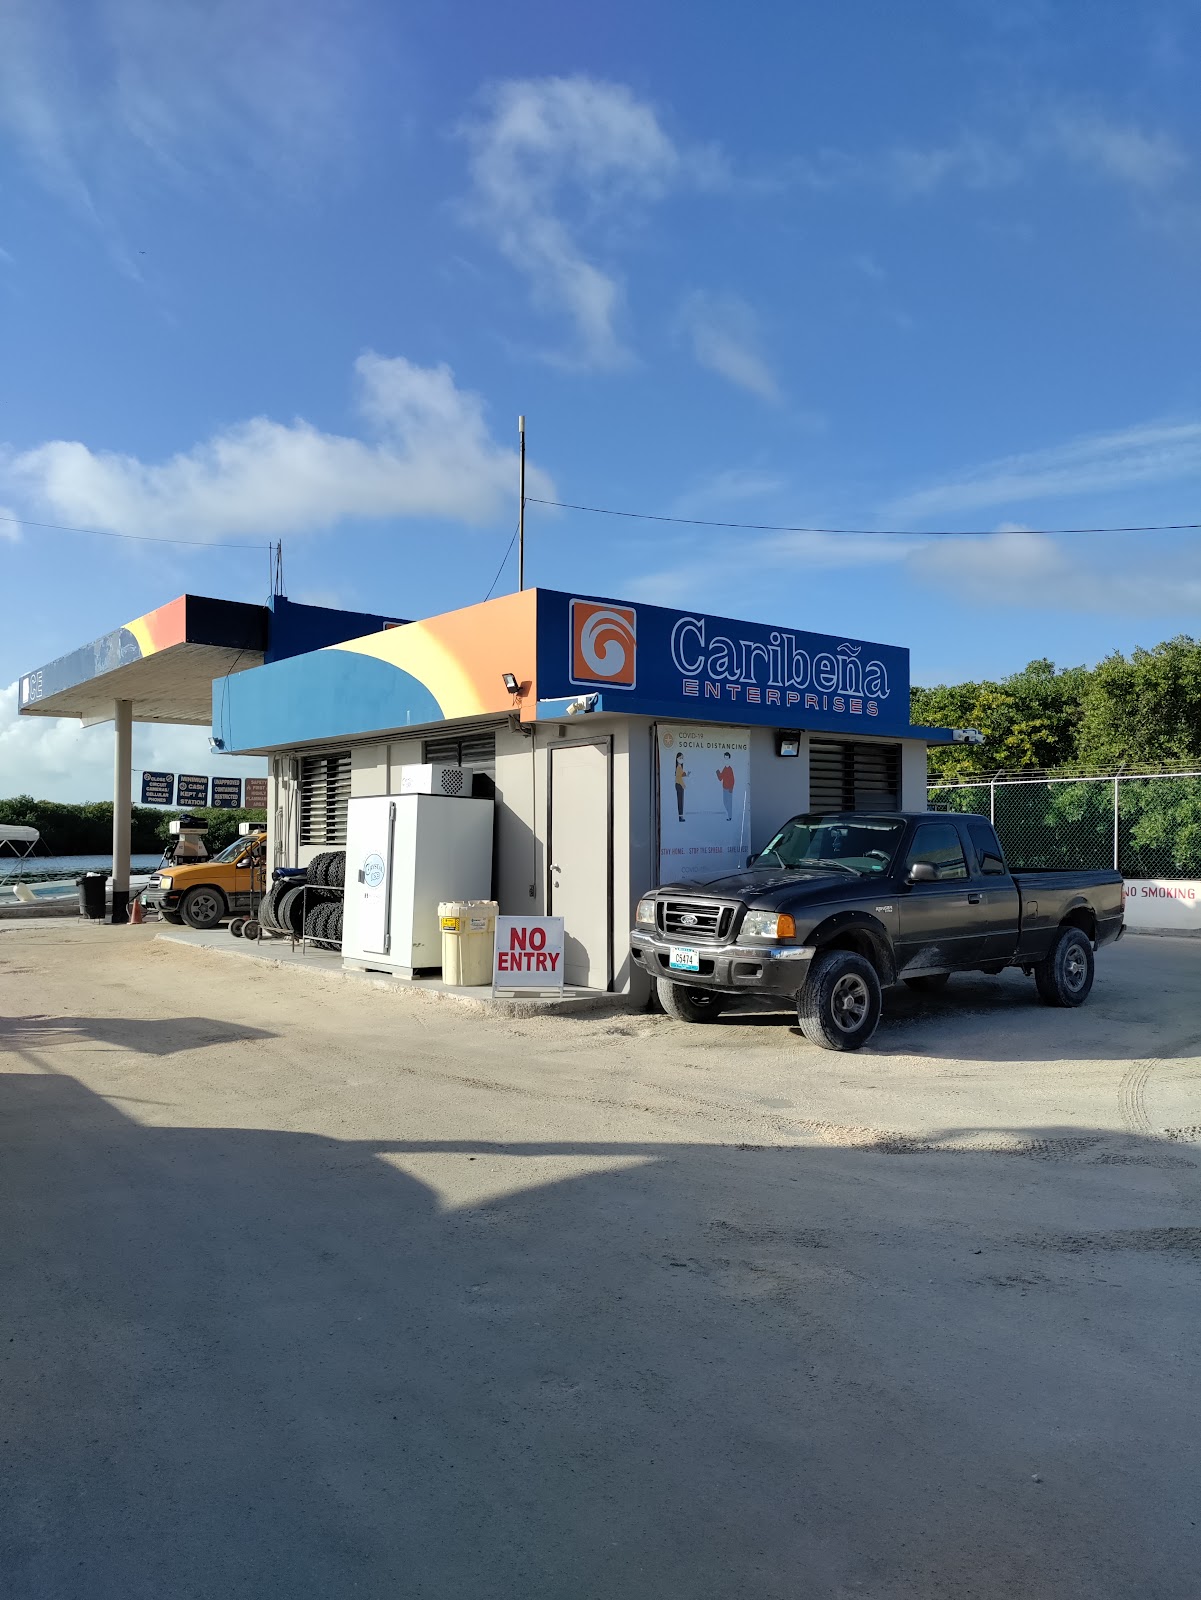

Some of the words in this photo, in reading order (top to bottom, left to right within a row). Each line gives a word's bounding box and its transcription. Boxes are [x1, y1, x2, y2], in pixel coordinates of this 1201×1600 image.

[670, 616, 890, 699] Caribeña
[682, 678, 878, 717] ENTERPRISES
[707, 742, 747, 750] DISTANCING
[1141, 886, 1195, 899] SMOKING
[510, 927, 546, 951] NO
[498, 952, 560, 972] ENTRY
[676, 954, 692, 964] C5474
